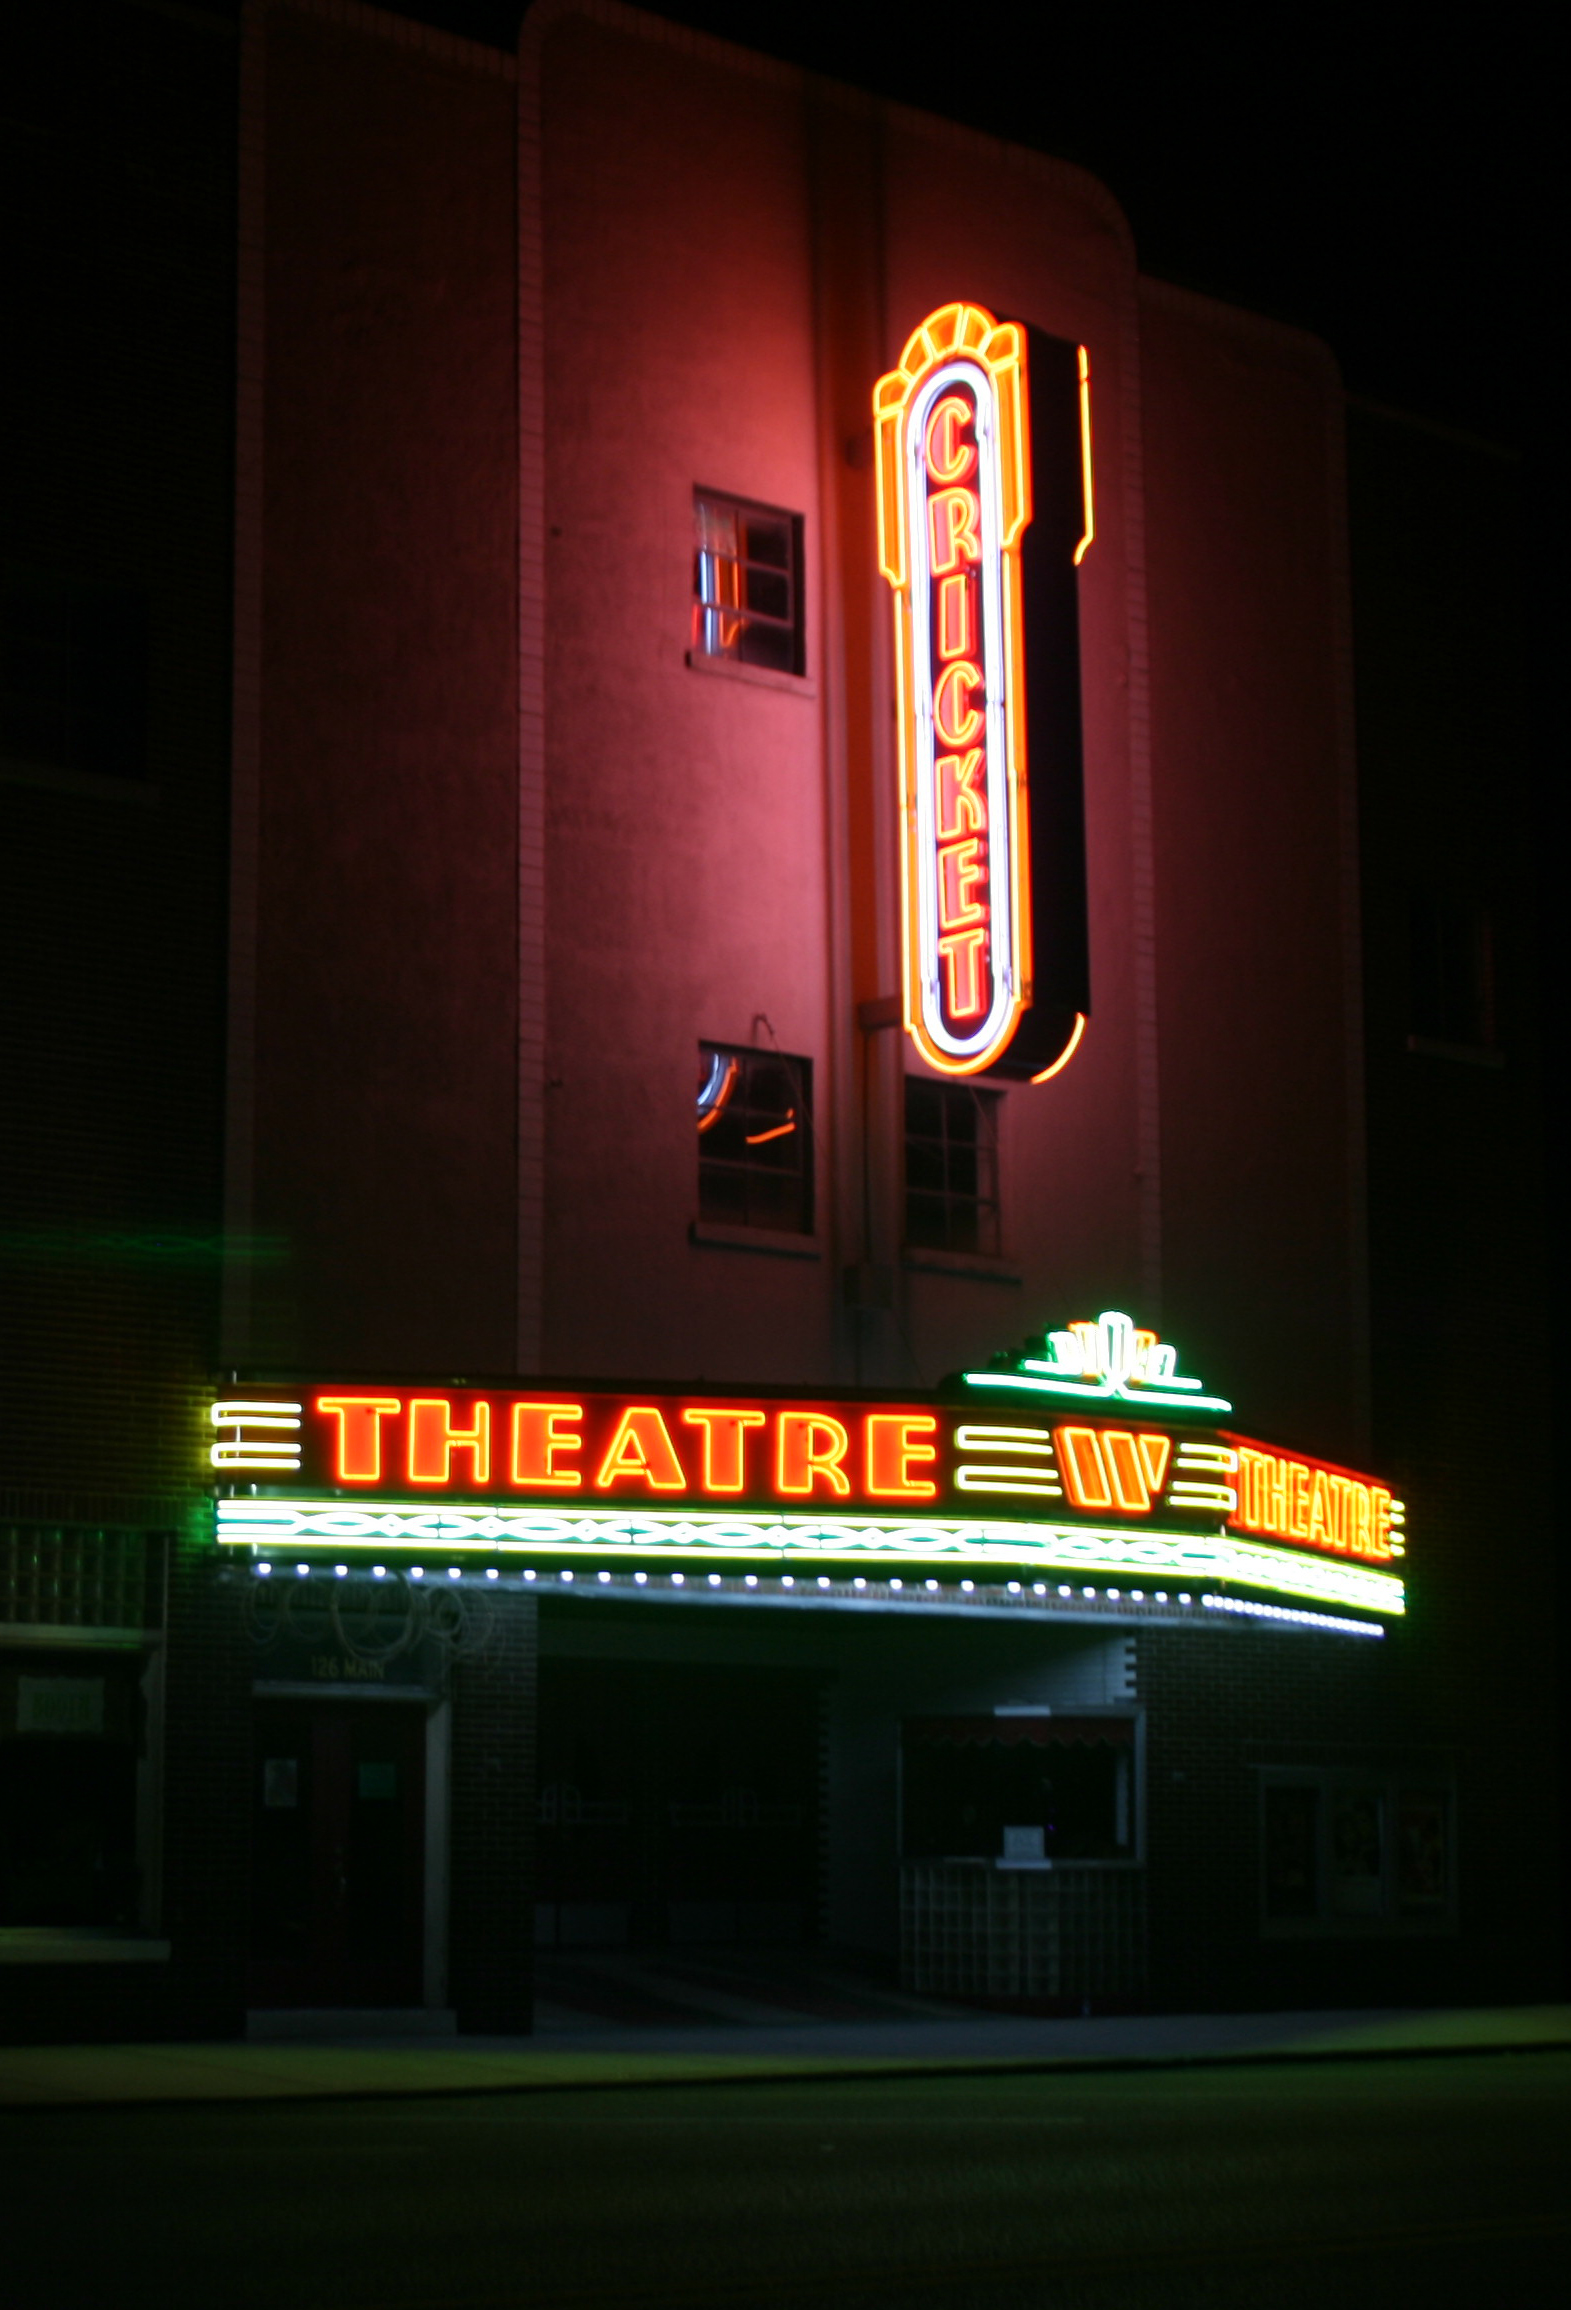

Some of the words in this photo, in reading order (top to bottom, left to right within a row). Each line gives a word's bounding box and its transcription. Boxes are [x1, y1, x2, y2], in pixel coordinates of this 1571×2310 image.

[925, 395, 989, 1018] CRICKET
[316, 1394, 939, 1498] THEATRE
[1234, 1445, 1393, 1560] THEATRE
[310, 1655, 340, 1679] 126
[343, 1656, 385, 1680] MAIN
